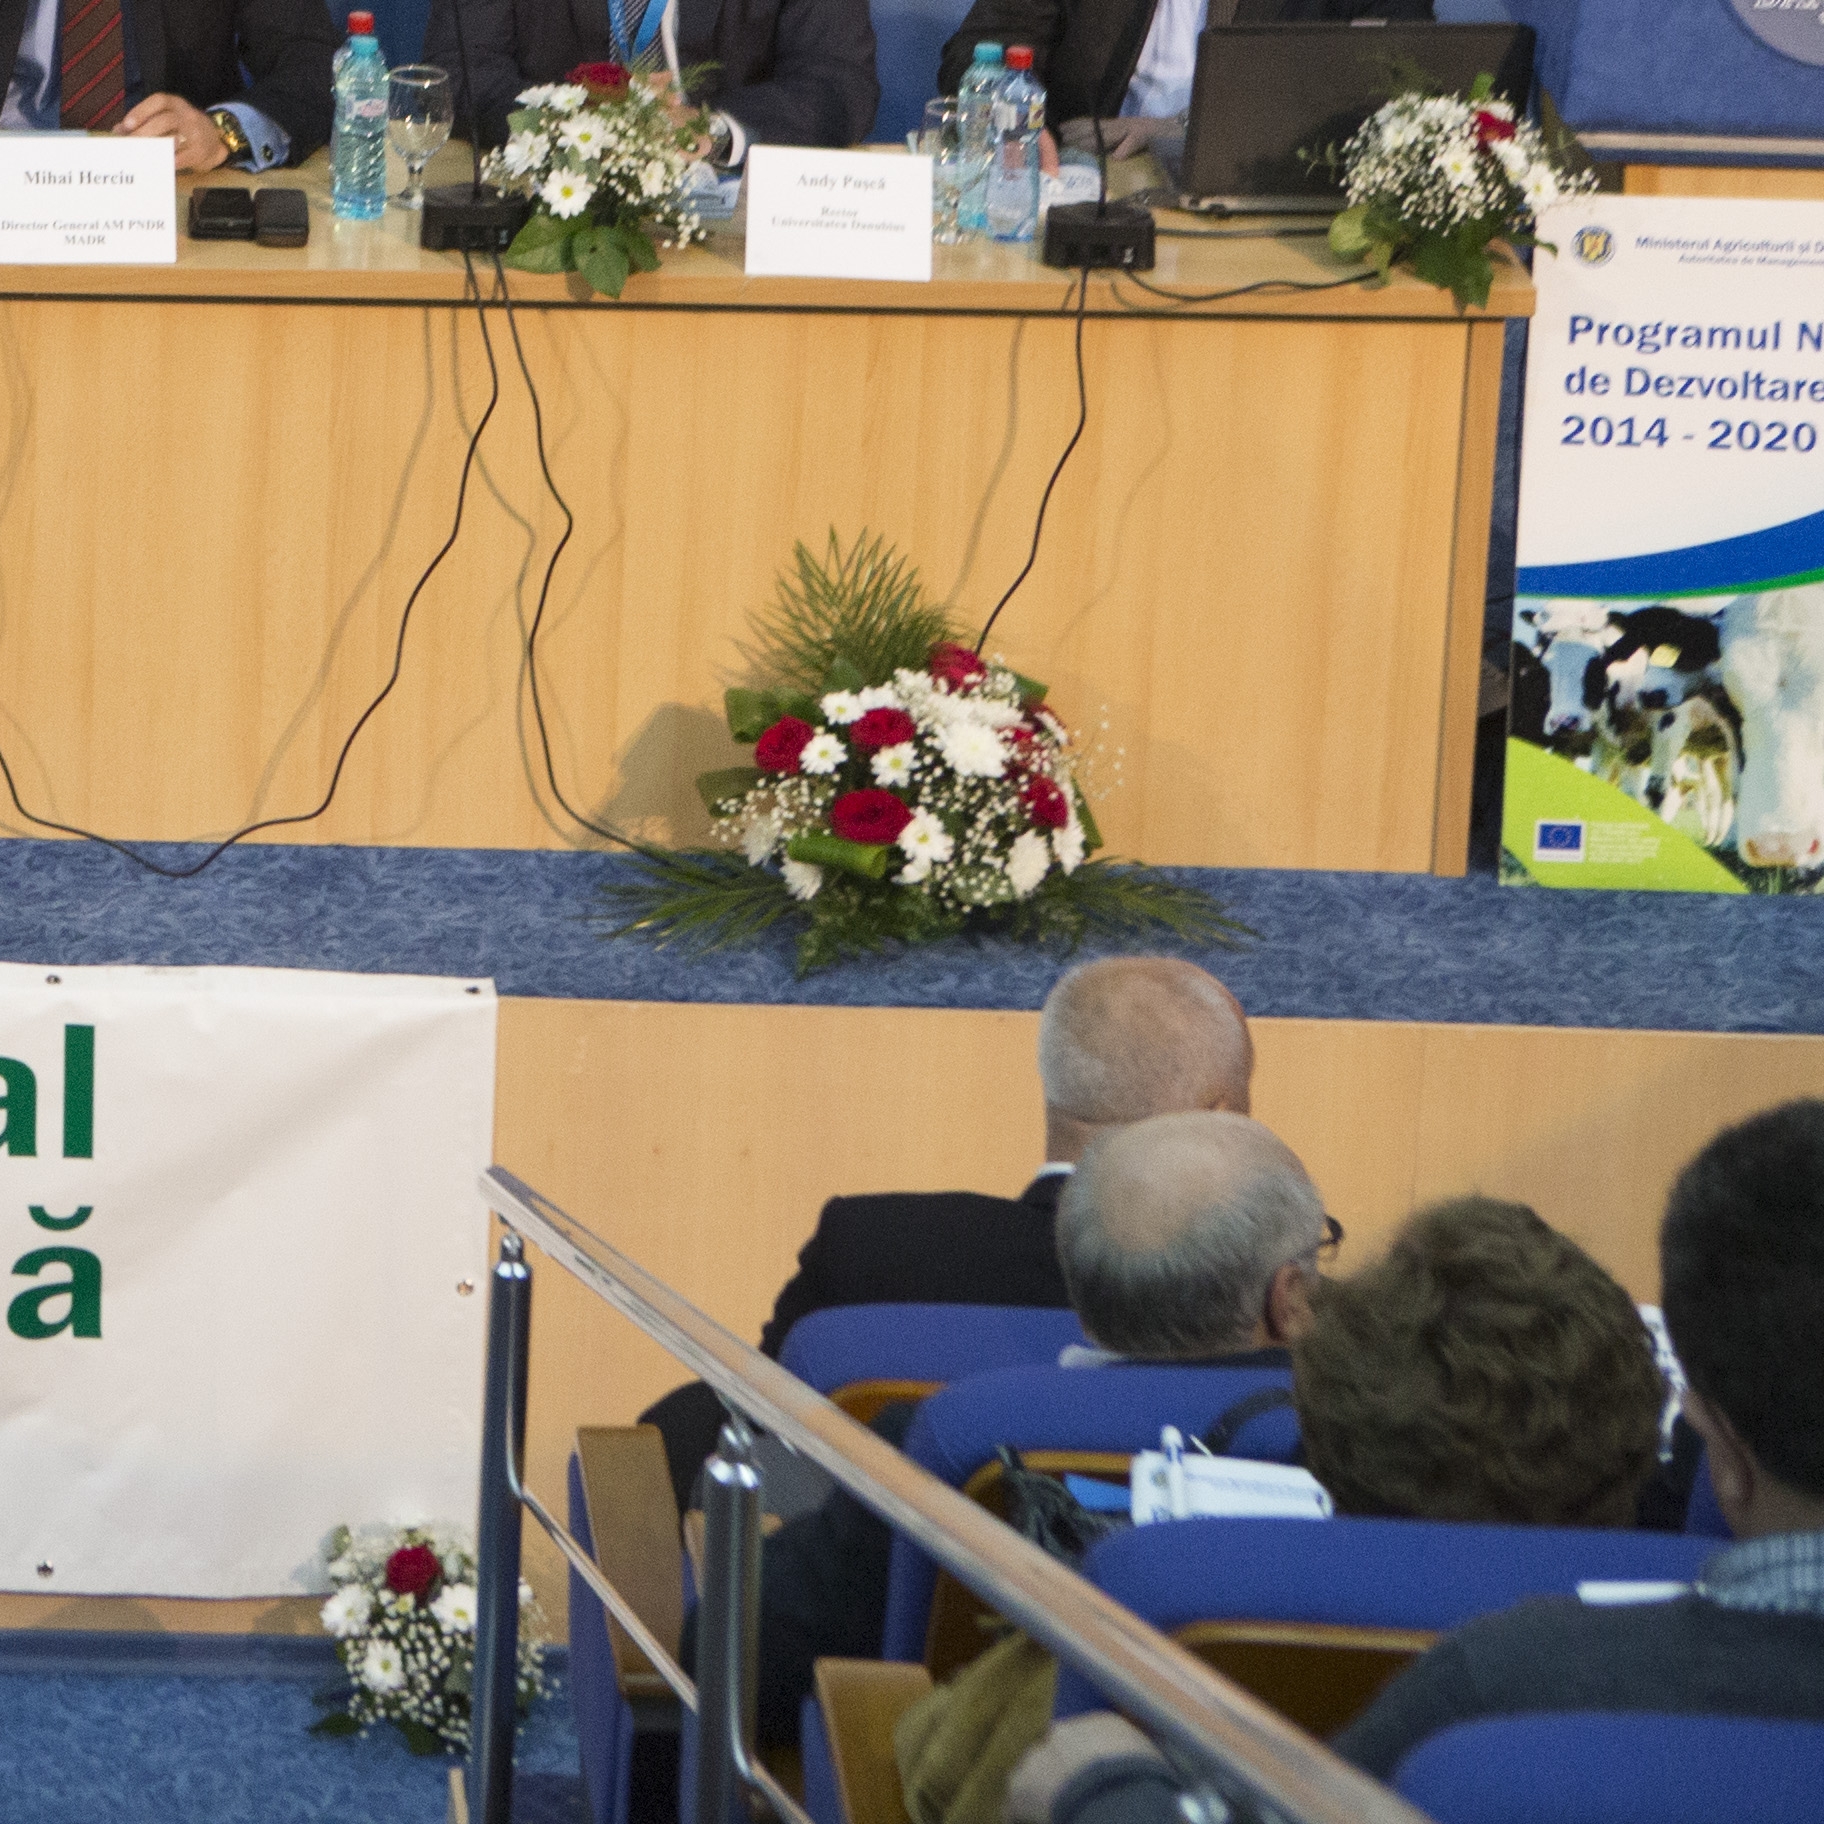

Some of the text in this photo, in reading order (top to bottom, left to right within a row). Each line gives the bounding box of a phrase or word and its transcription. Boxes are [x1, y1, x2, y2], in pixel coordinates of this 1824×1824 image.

[23, 170, 135, 185] Mihai Herciu
[796, 173, 838, 190] Andy
[1, 219, 166, 231] Director General AM PNDR
[64, 234, 107, 245] MADR
[1568, 314, 1782, 355] Programul
[1564, 365, 1824, 403] de Dezvoltare
[1560, 414, 1670, 448] 2014
[1707, 419, 1818, 453] 2020
